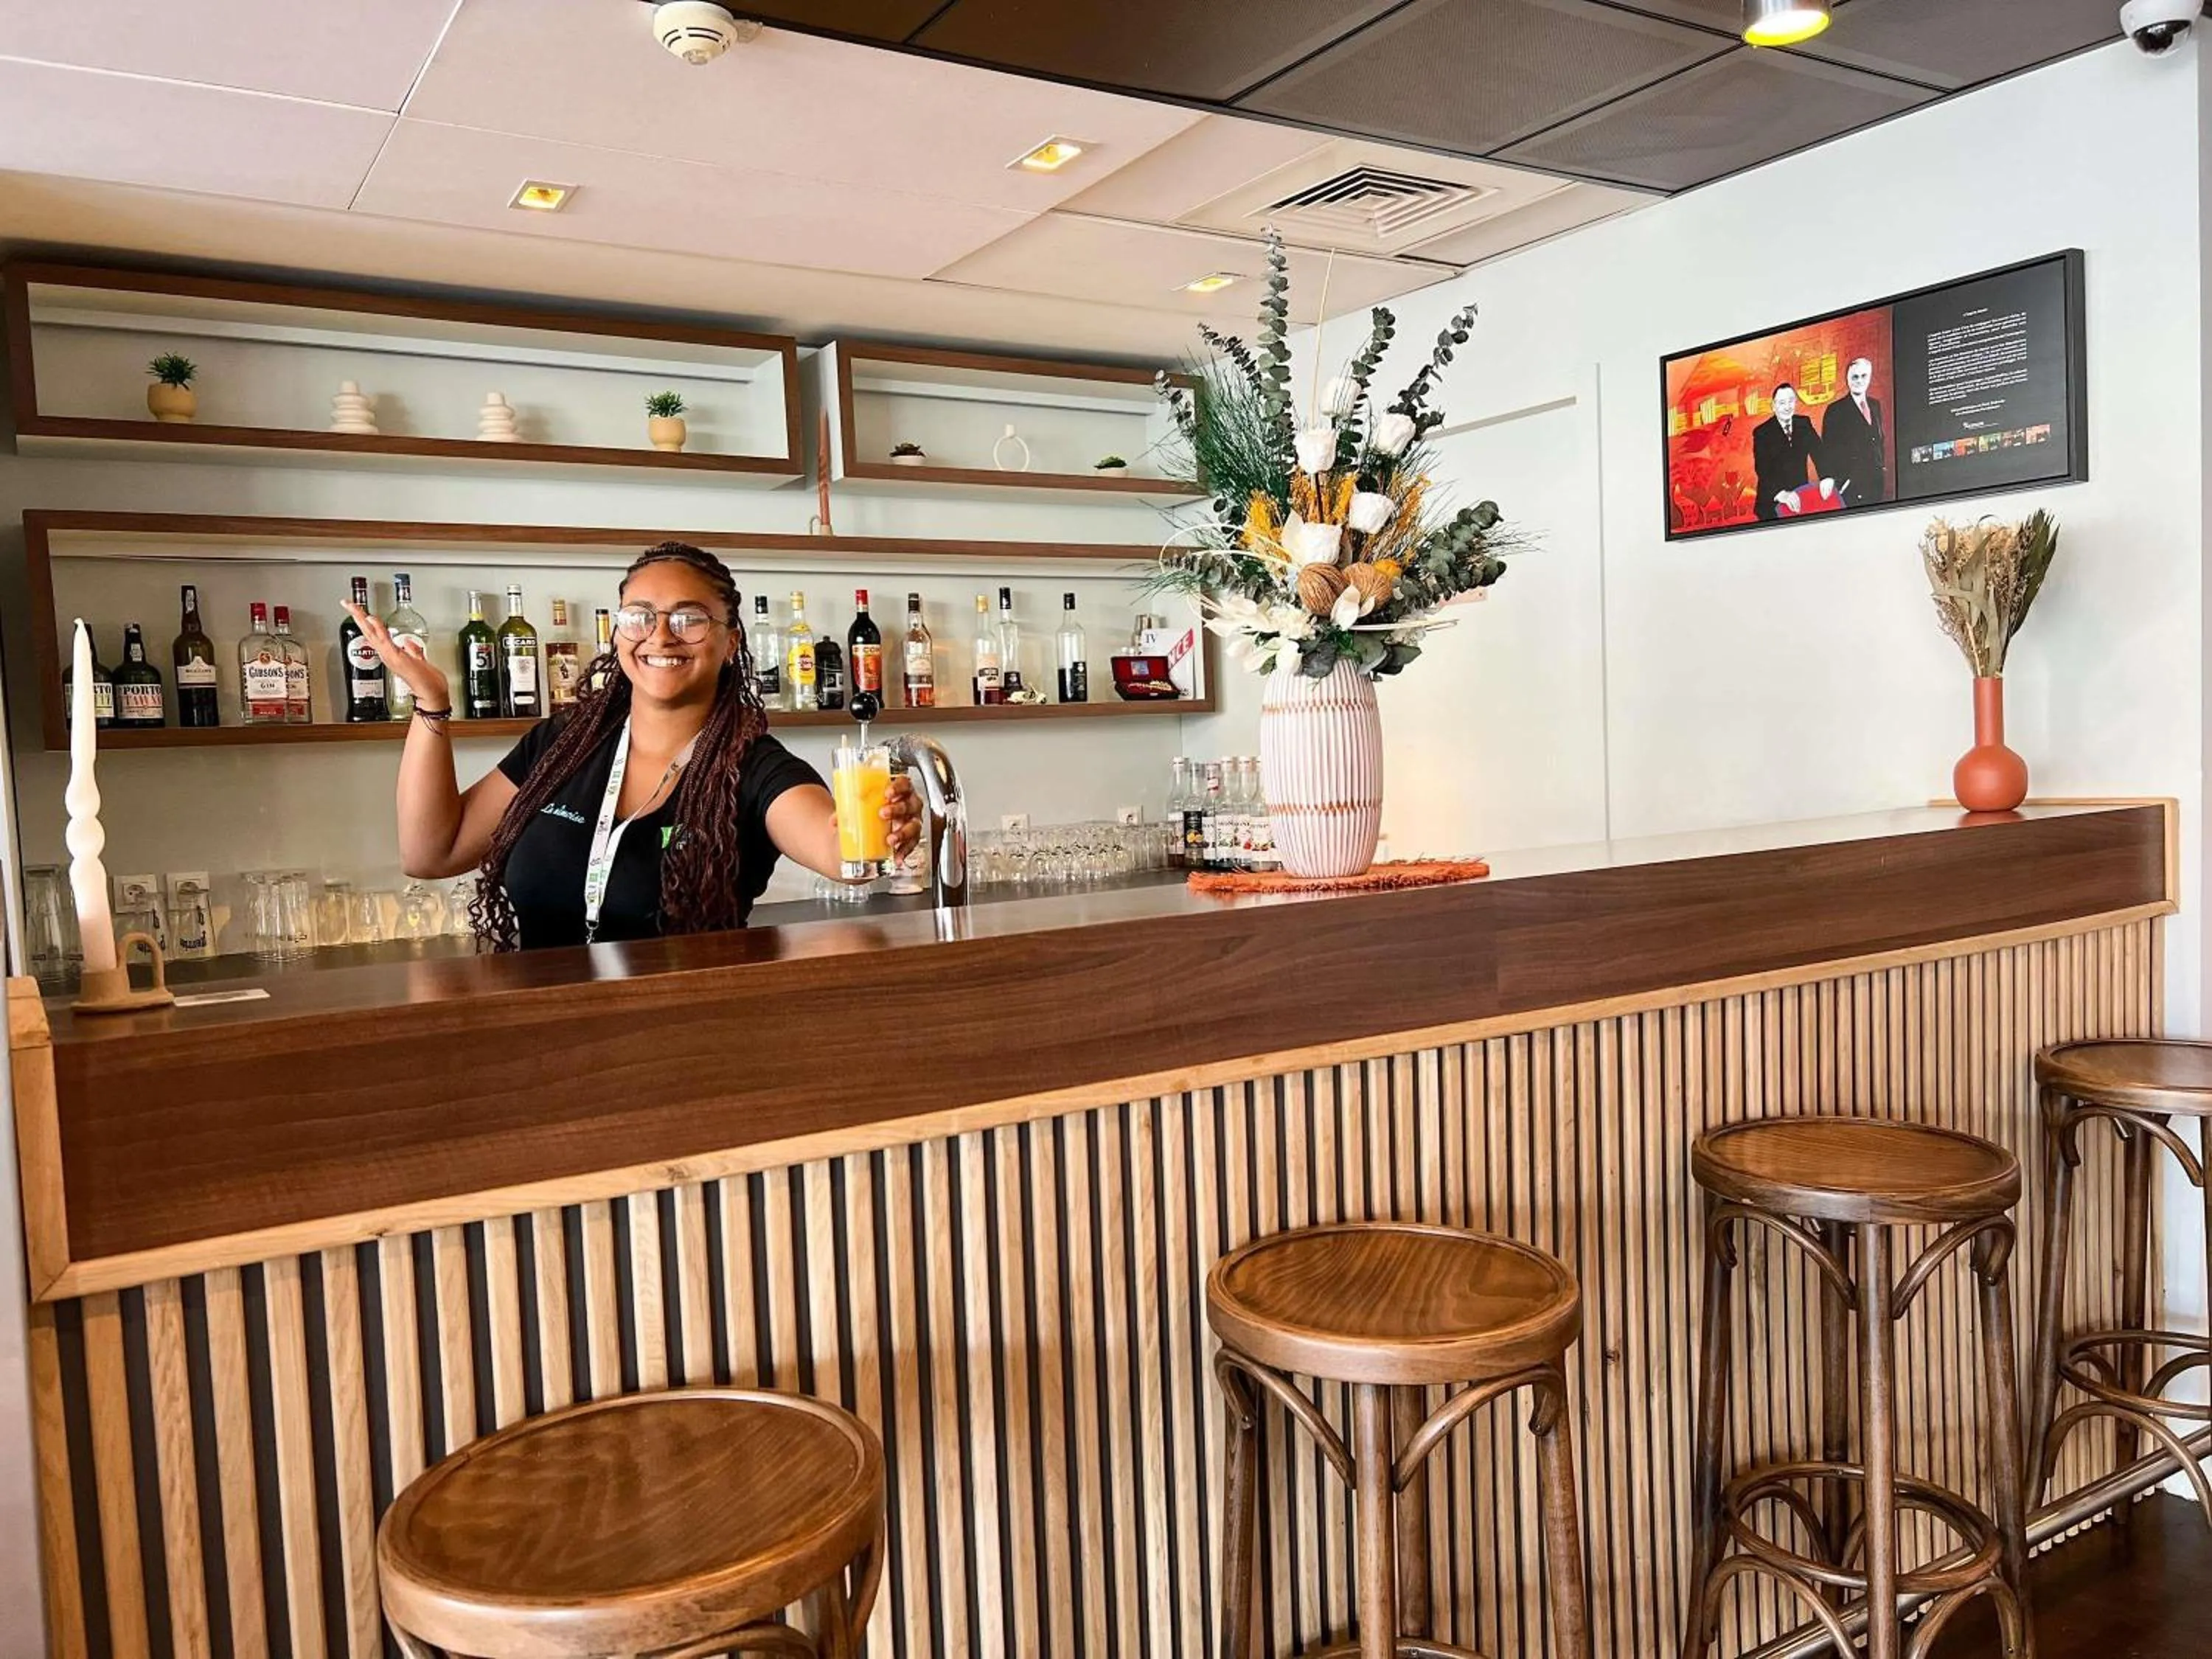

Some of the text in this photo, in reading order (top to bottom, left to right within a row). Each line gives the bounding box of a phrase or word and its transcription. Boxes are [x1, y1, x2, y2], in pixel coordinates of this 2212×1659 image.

[351, 648, 378, 657] MARTI
[476, 651, 493, 668] 51
[248, 666, 284, 678] GIBSON'S
[285, 669, 305, 679] SON'S
